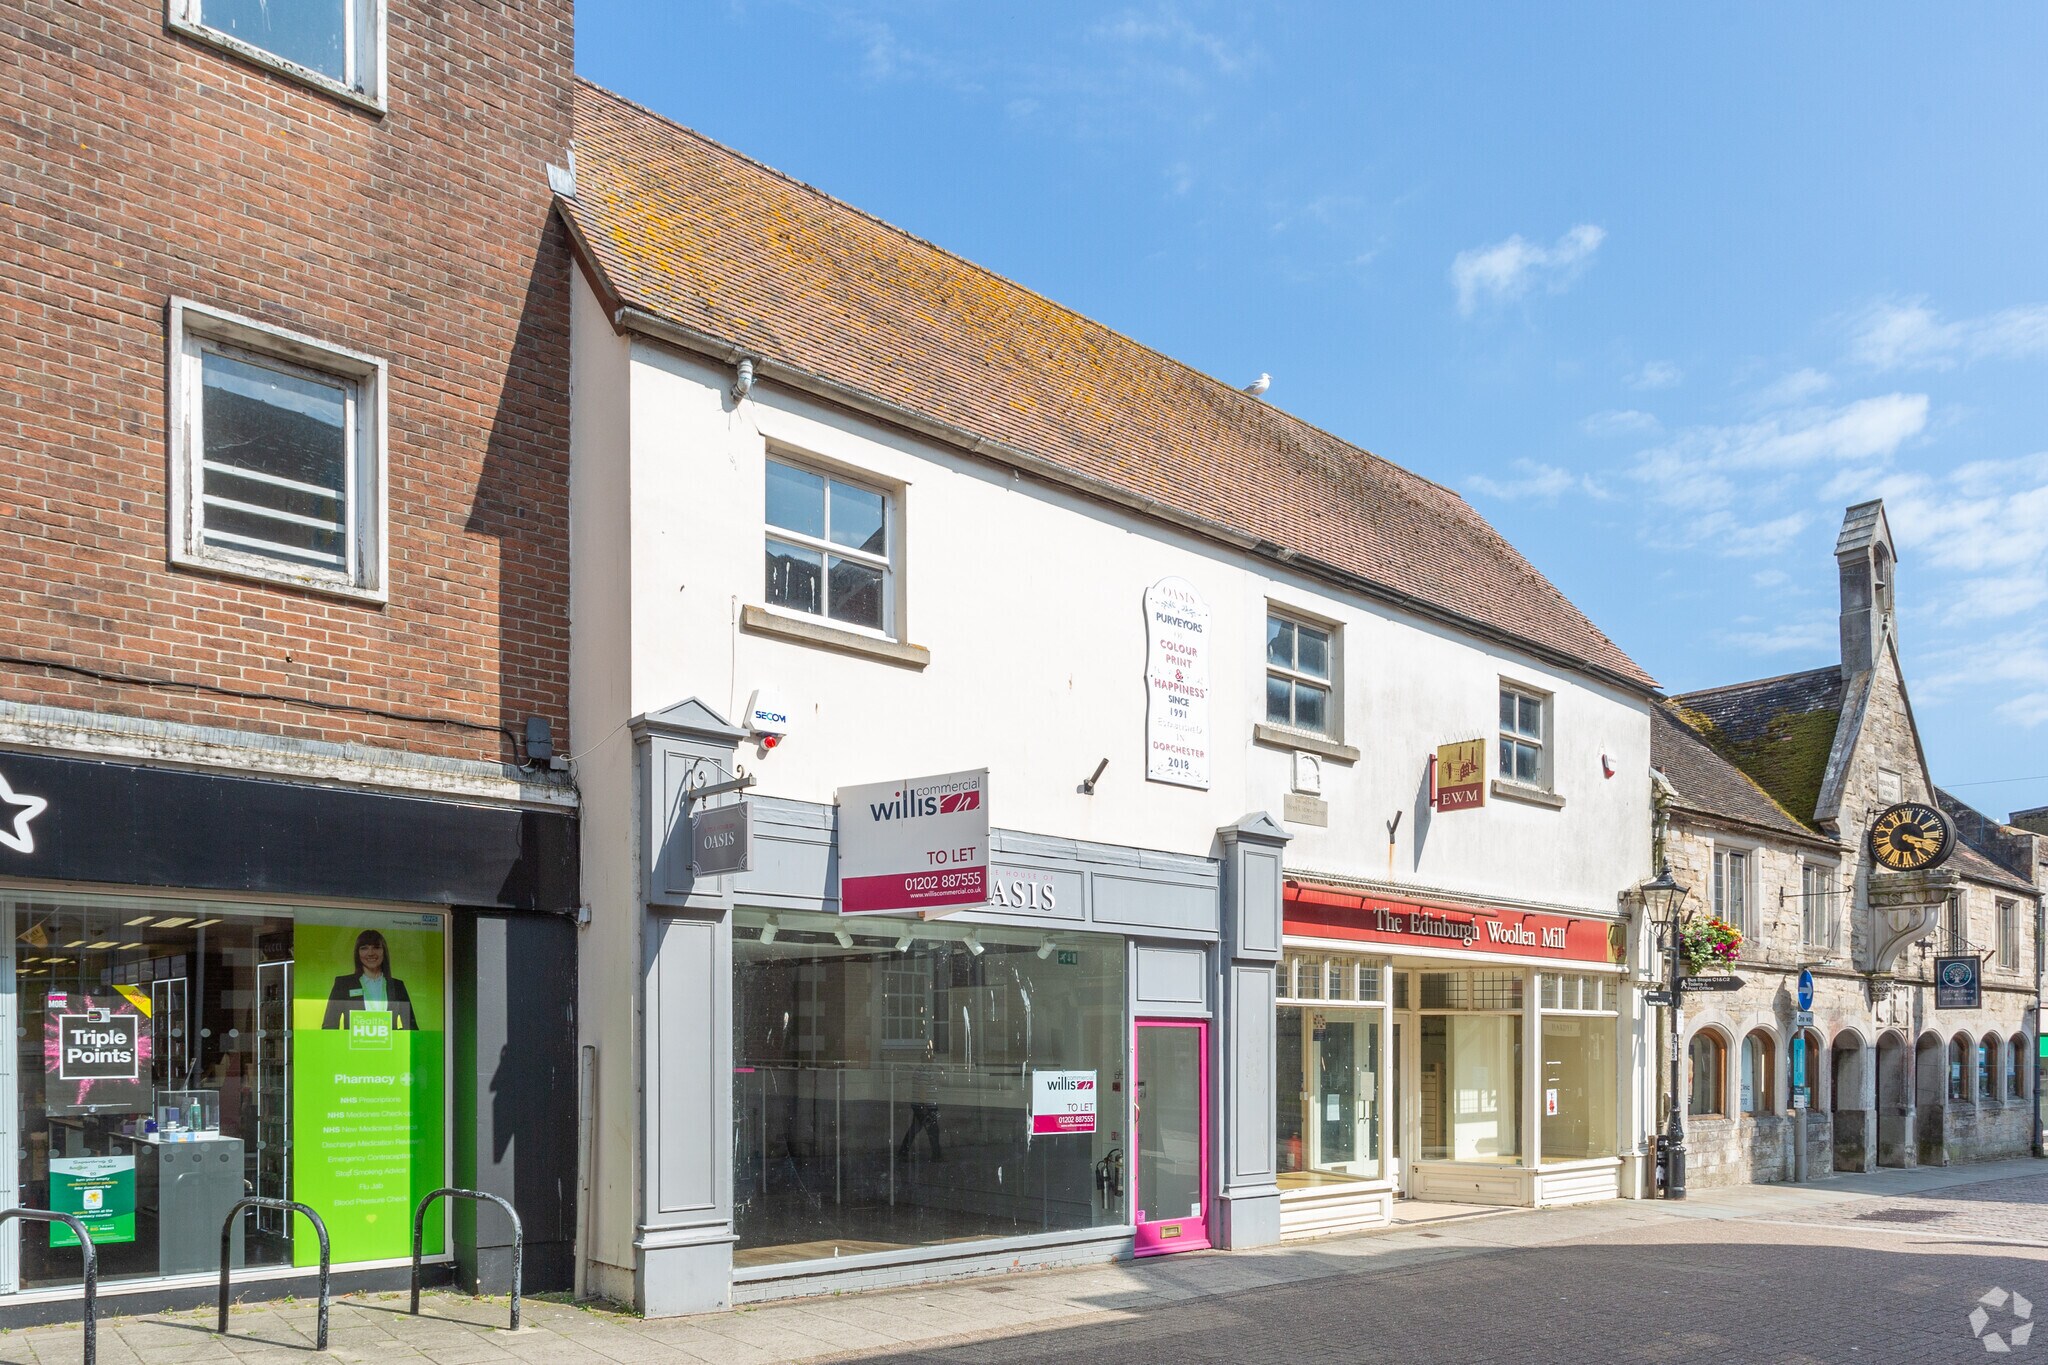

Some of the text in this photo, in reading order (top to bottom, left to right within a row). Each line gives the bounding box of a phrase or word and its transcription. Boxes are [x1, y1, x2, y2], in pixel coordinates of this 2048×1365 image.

[1156, 612, 1202, 633] PURVEYORS
[1160, 639, 1197, 657] COLOUR
[1166, 654, 1192, 668] PRINT
[1175, 669, 1183, 680] &
[1154, 678, 1204, 698] HAPPINESS
[1168, 695, 1189, 707] SINCE
[755, 711, 786, 723] SECOM
[1170, 708, 1187, 718] 1991
[1153, 741, 1204, 758] DORCHESTER
[1168, 757, 1189, 769] 2018
[870, 776, 980, 822] willis commercial
[1441, 789, 1478, 806] EWM
[704, 832, 735, 850] OASIS
[927, 847, 976, 865] TO LET
[905, 876, 938, 891] 01202
[941, 872, 981, 888] 887555
[1006, 871, 1036, 880] HOUSE
[910, 887, 982, 899] www.williscommercial.co.uk
[990, 879, 1056, 911] ASIS
[1373, 906, 1567, 950] The Edinburgh Woollen Mill
[48, 1000, 67, 1008] MORE
[353, 1017, 384, 1025] health
[353, 1025, 388, 1037] HUB
[70, 1029, 127, 1048] Triple
[334, 1074, 395, 1085] Pharmacy
[1047, 1076, 1076, 1090] willis
[359, 1096, 402, 1104] Prescriptions
[1067, 1102, 1093, 1112] TO LET
[328, 1111, 344, 1119] NHS
[1058, 1115, 1093, 1124] 01202 887555
[323, 1126, 340, 1134] NHS
[322, 1141, 356, 1149] Discharge
[368, 1153, 413, 1161] Contraception
[334, 1199, 354, 1207] Blood
